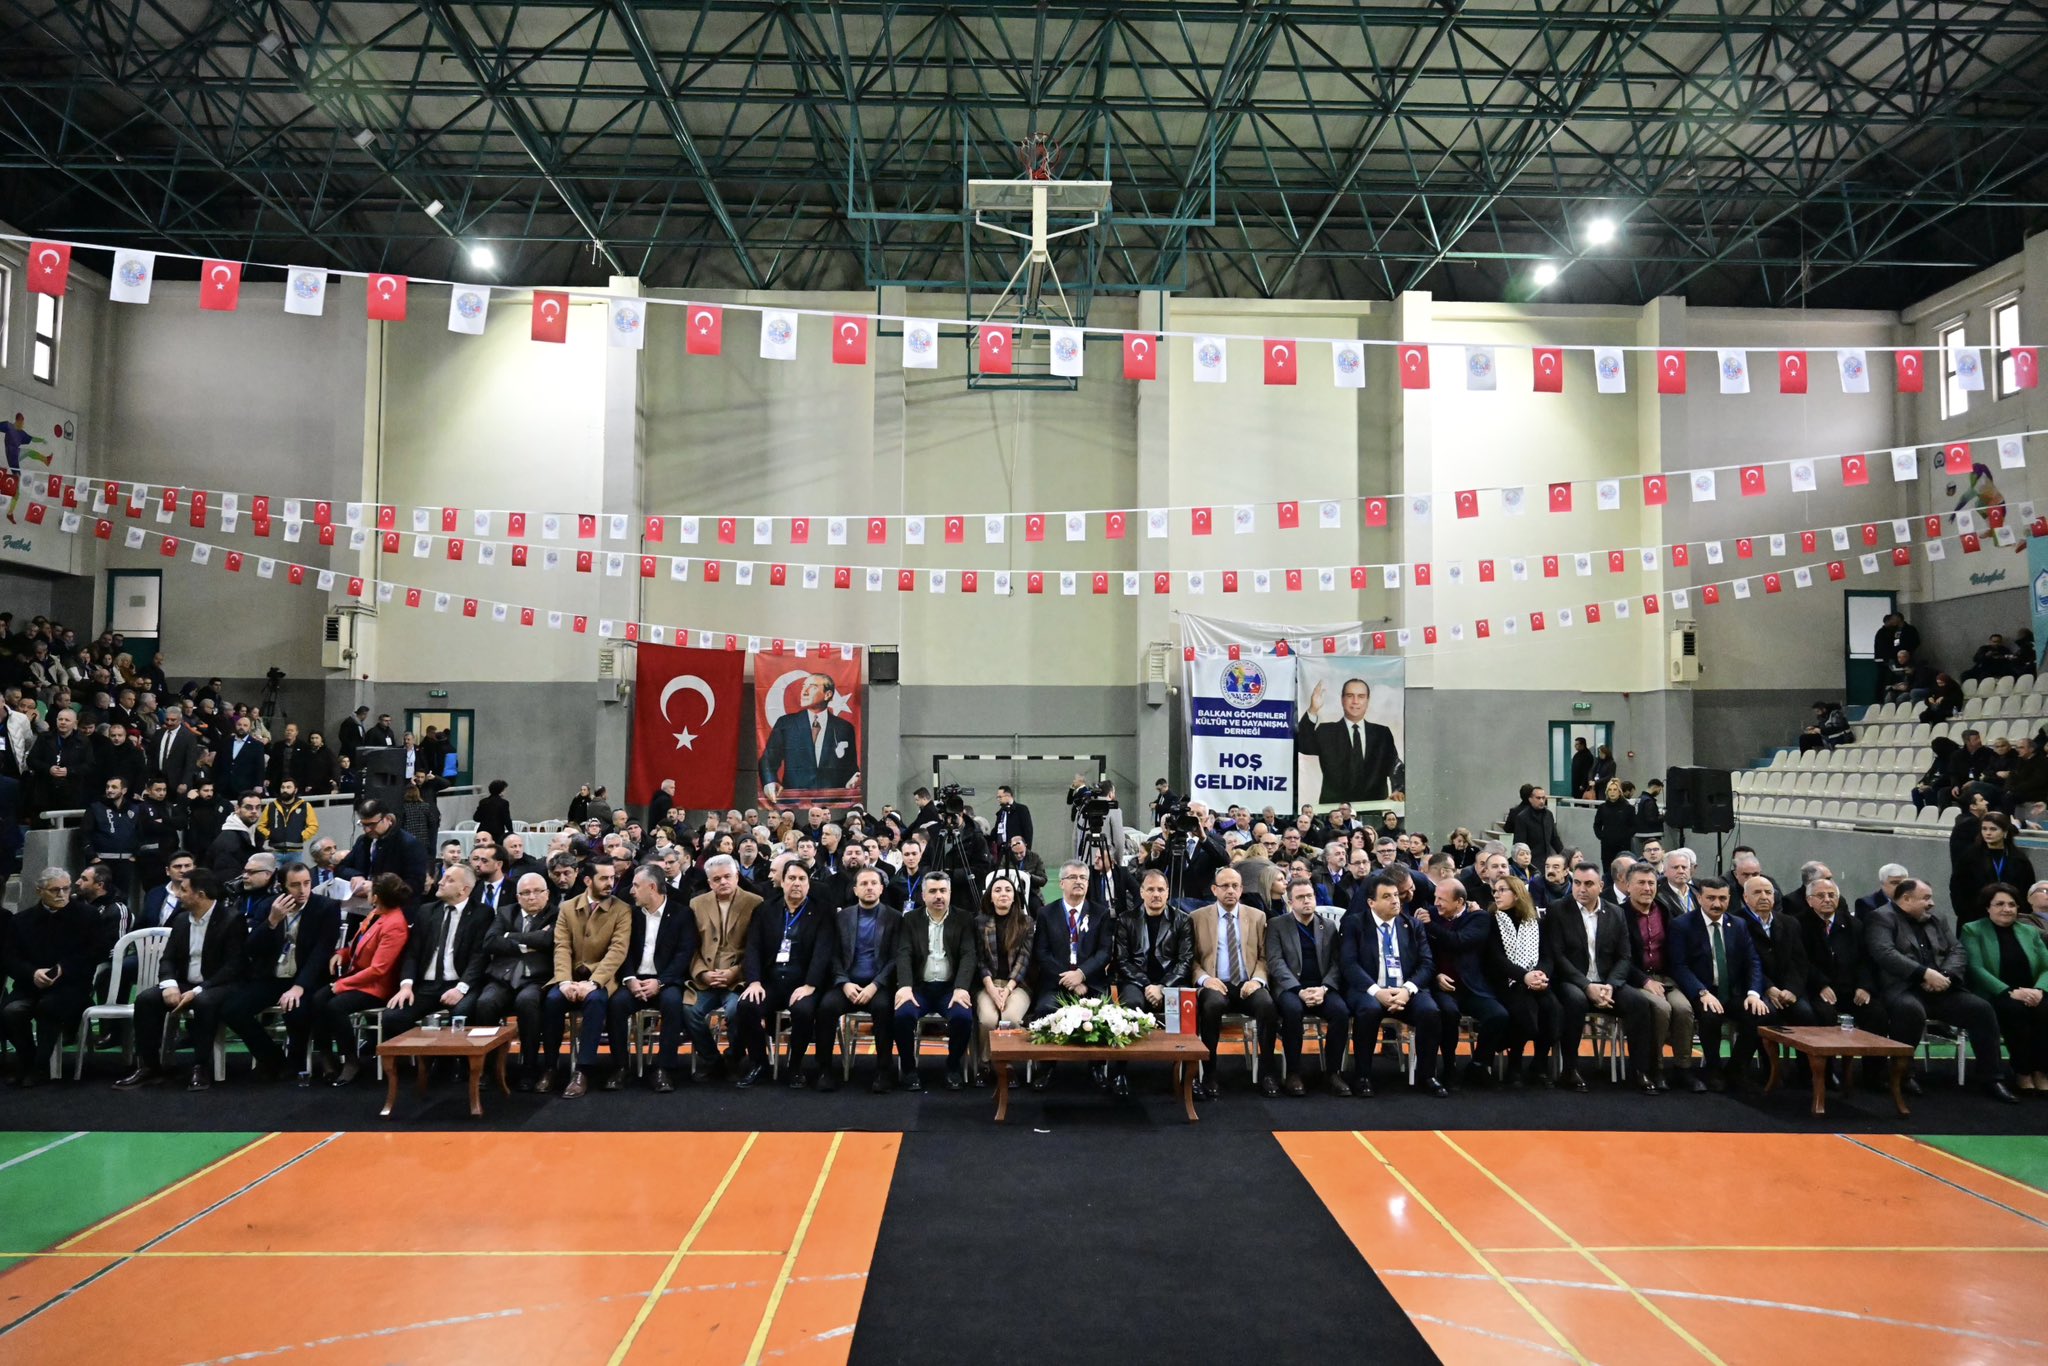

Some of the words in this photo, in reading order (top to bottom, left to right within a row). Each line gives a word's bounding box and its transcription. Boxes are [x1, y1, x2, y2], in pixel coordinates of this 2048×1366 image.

[1197, 710, 1232, 718] BALKAN
[1234, 710, 1287, 719] GÖÇMENLERİ
[1195, 717, 1227, 725] KÜLTÜR
[1242, 720, 1288, 728] DAYANIŞMA
[1224, 727, 1260, 735] DERNEĞİ
[1219, 753, 1262, 771] HOŞ
